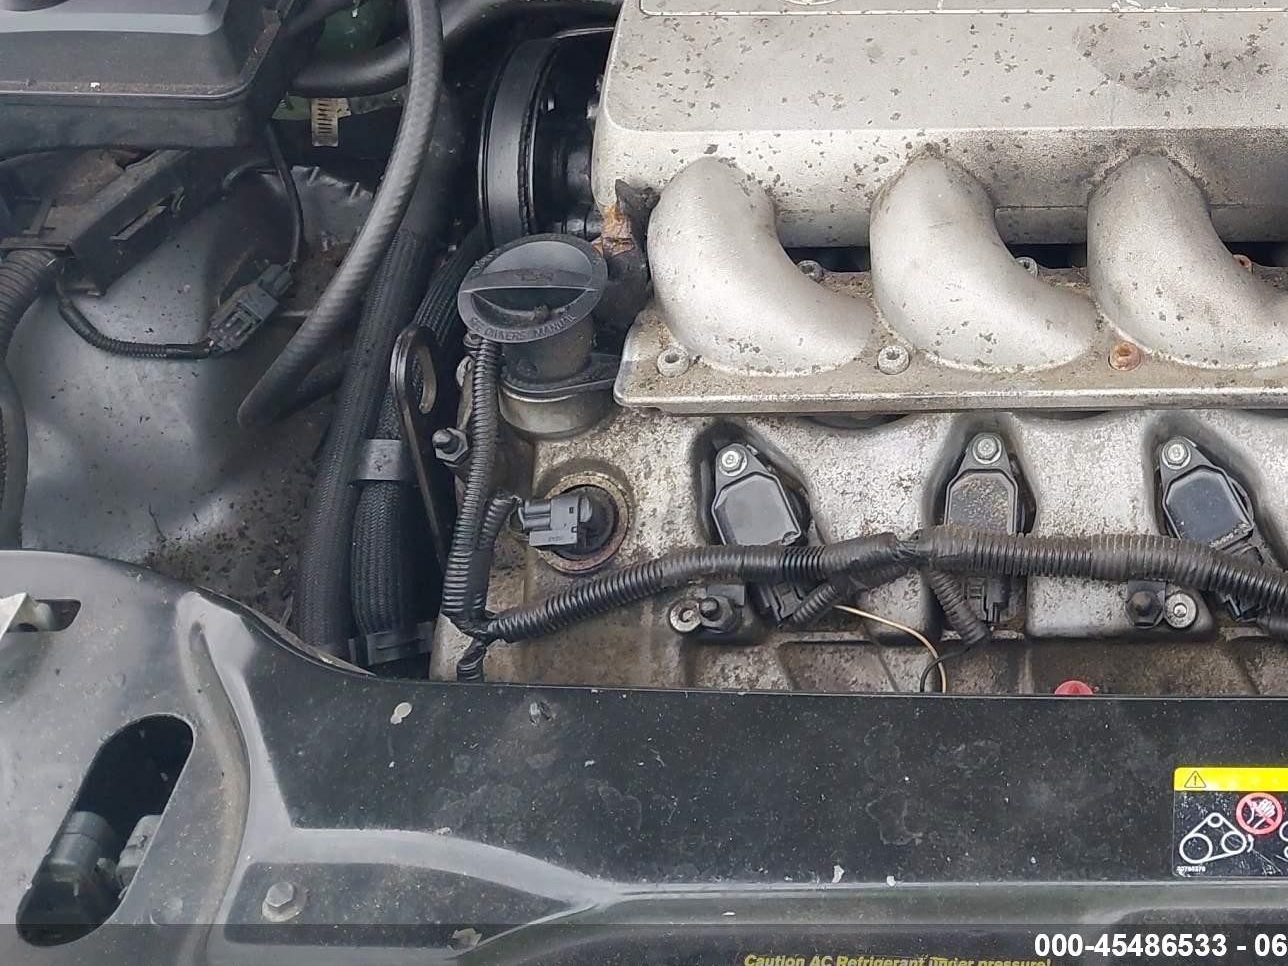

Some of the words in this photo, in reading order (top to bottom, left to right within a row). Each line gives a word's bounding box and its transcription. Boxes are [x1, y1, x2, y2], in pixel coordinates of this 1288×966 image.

[534, 315, 577, 338] MANUAL
[744, 954, 806, 966] Caution
[809, 954, 834, 966] AC
[836, 954, 926, 966] Refrigerant
[929, 957, 974, 966] under
